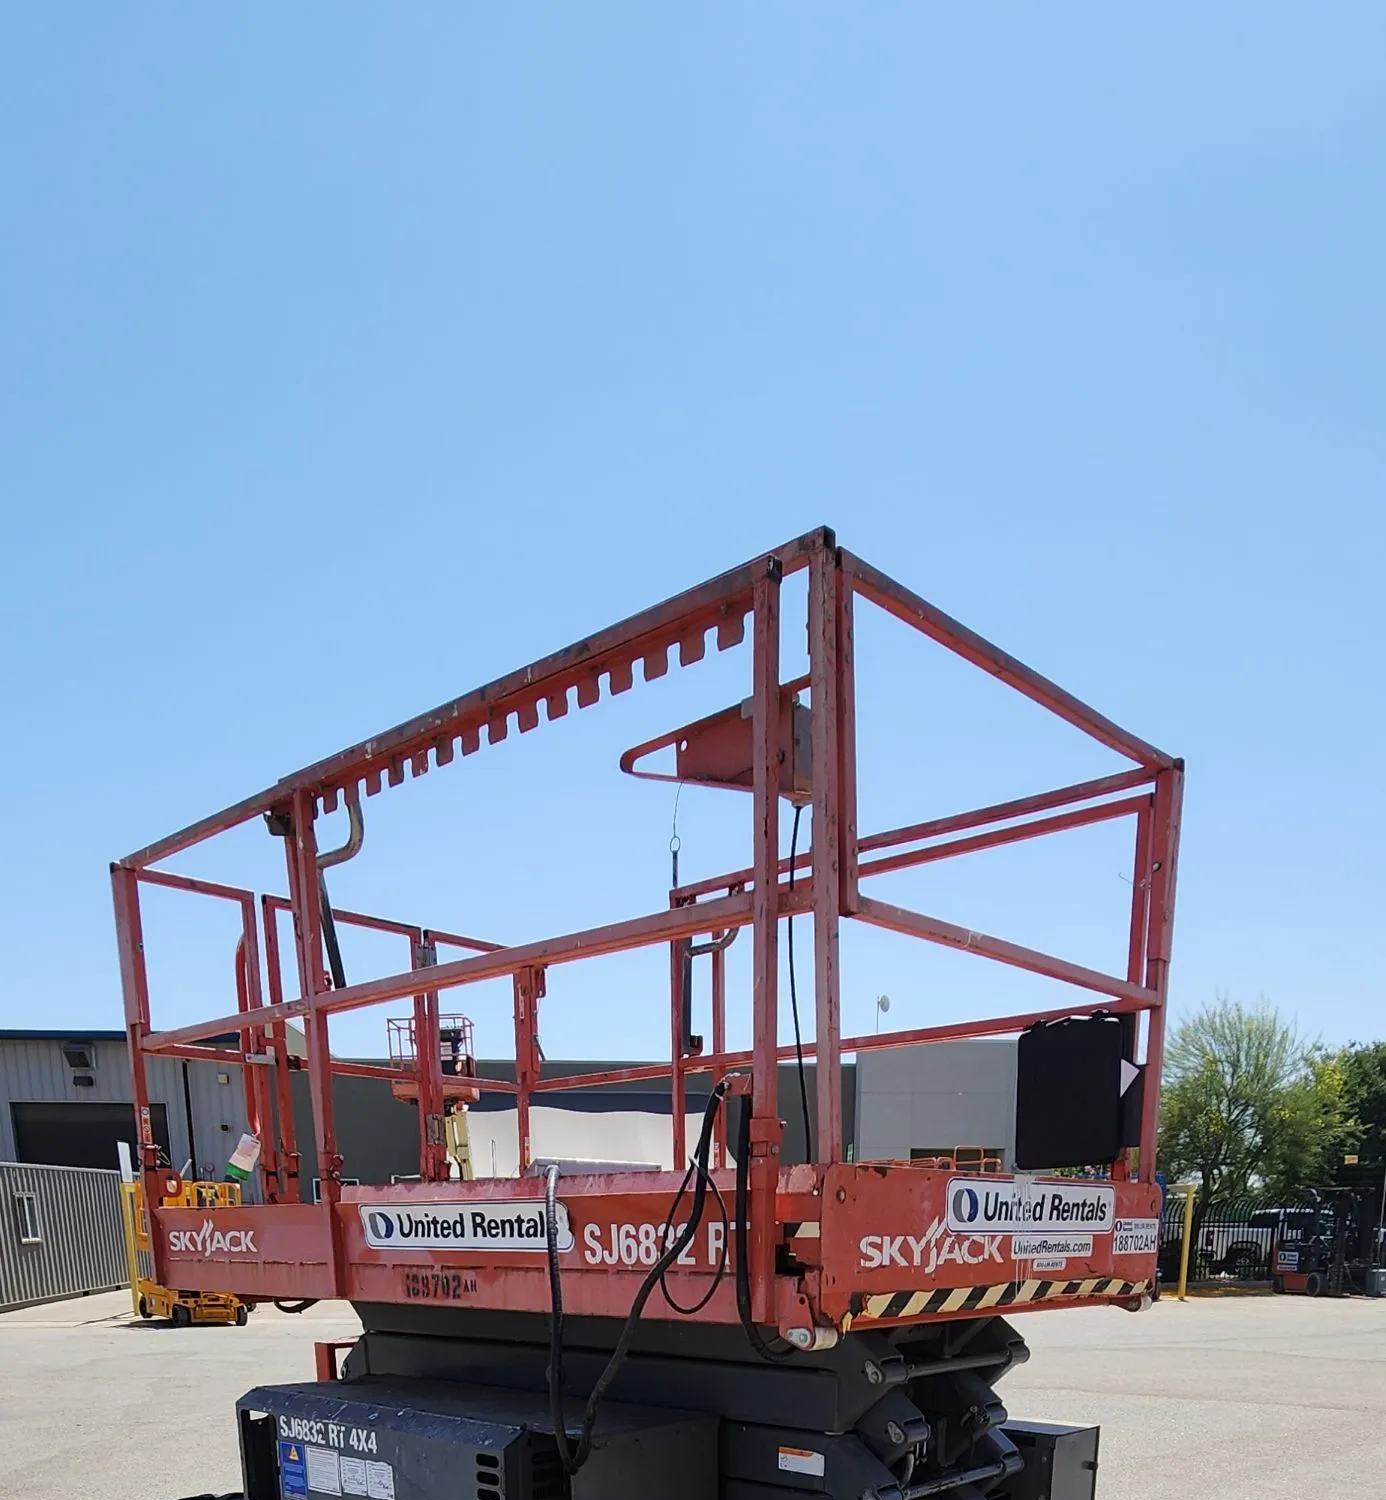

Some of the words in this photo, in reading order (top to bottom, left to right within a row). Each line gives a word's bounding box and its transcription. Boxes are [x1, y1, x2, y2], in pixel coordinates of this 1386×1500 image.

[397, 1212, 464, 1238] United
[470, 1210, 558, 1239] Rental
[984, 1191, 1045, 1222] United
[1049, 1193, 1107, 1223] Rentals
[168, 1218, 258, 1257] SKYJACK
[707, 1221, 751, 1266] R
[859, 1216, 1005, 1274] SKYJACK
[1013, 1239, 1091, 1255] UnitedRentals.com
[1114, 1234, 1157, 1252] 188702AH
[279, 1415, 326, 1445] SJ6832
[328, 1423, 346, 1449] RT
[349, 1428, 378, 1454] 4X4
